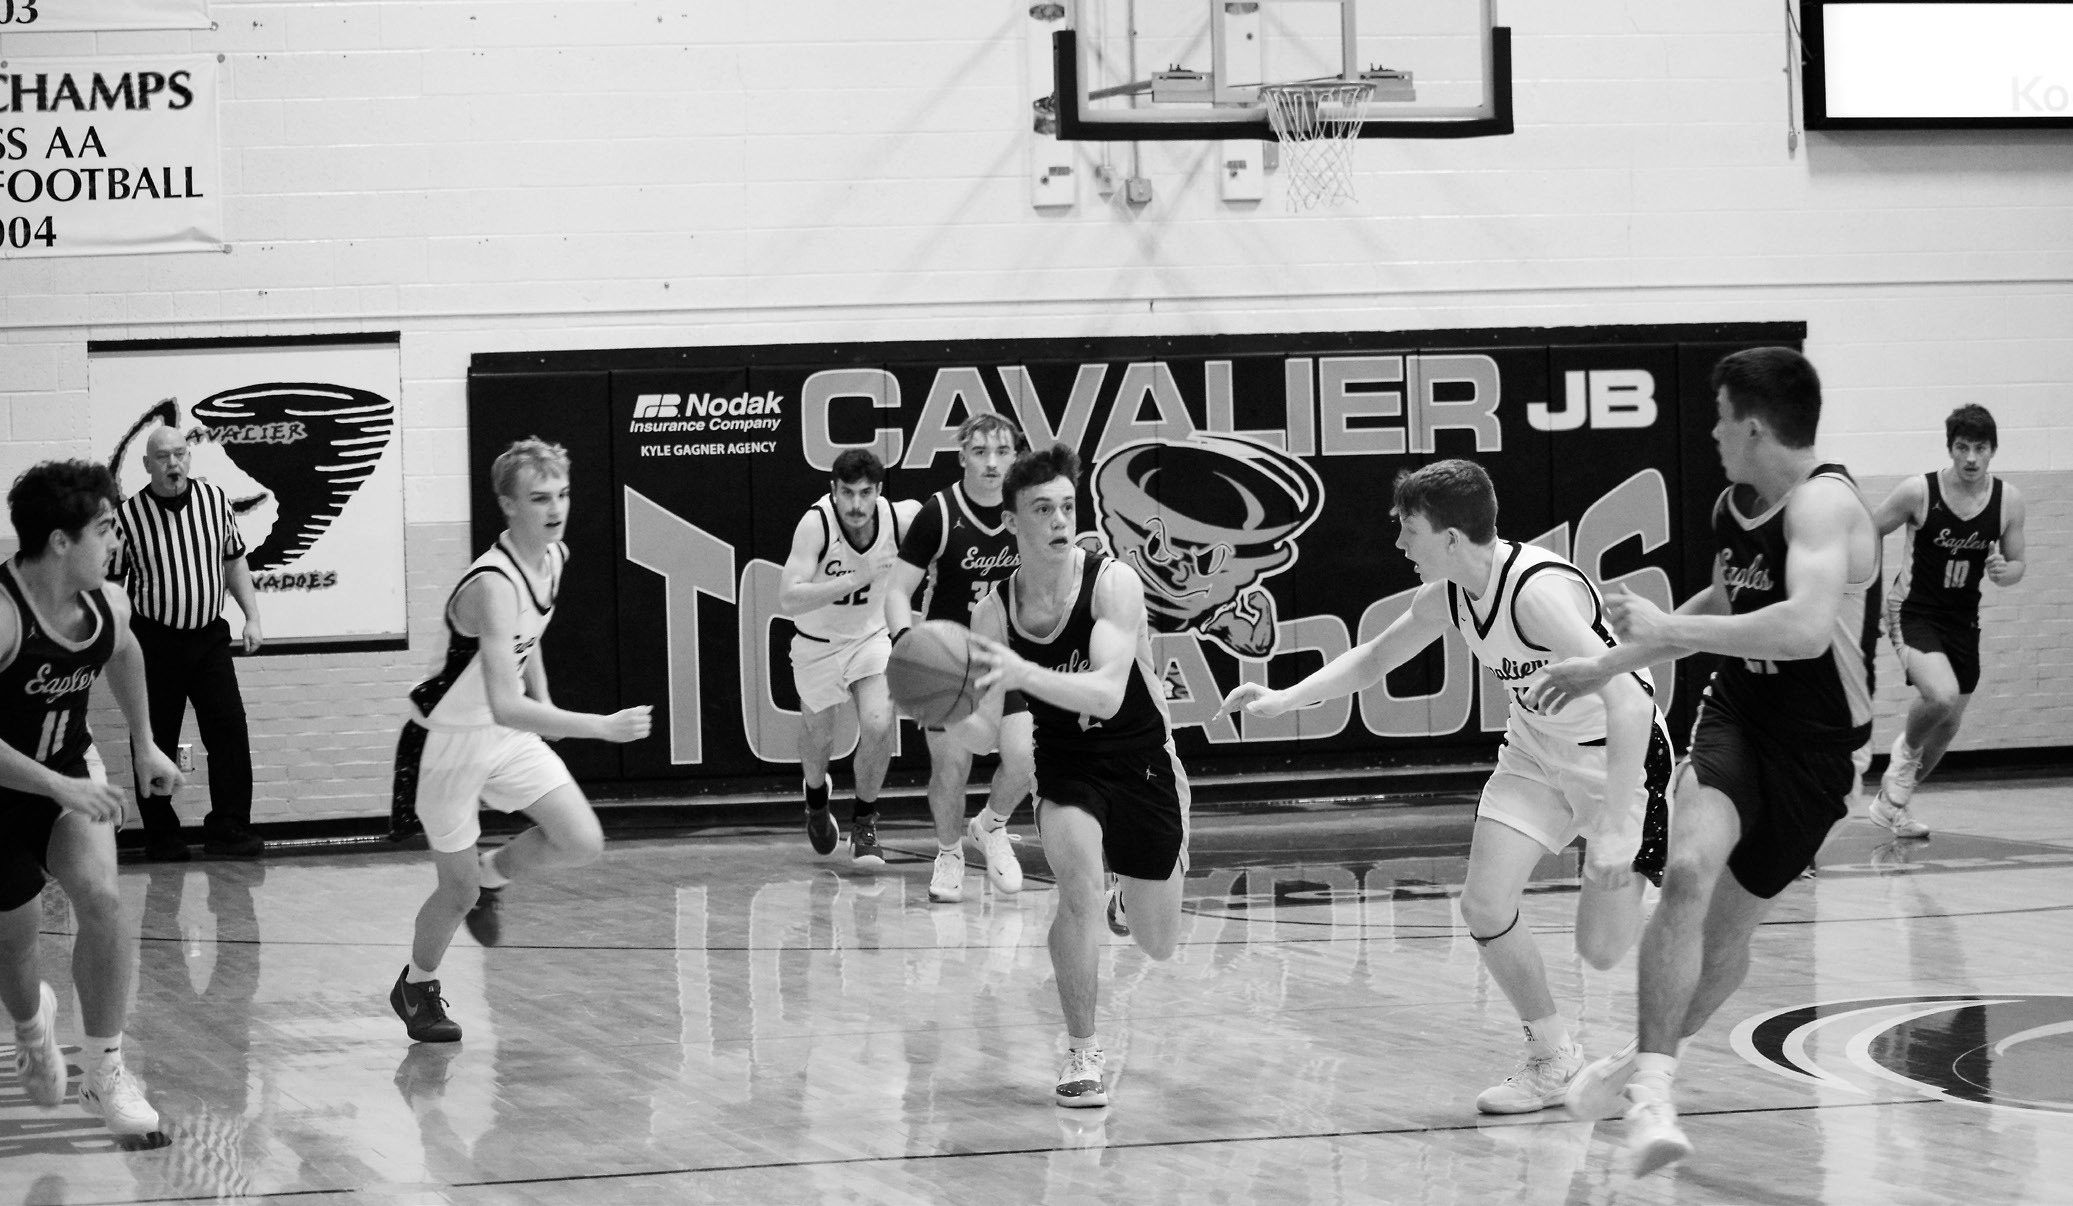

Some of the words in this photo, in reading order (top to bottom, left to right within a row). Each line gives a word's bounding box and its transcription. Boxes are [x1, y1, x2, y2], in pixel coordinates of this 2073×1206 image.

[0, 70, 194, 112] HAMPS
[2011, 75, 2073, 113] Ko
[0, 126, 28, 161] S
[45, 125, 107, 159] AA
[0, 166, 203, 203] OOTBALL
[0, 215, 57, 249] 04
[685, 390, 784, 417] Nodak
[801, 353, 1503, 472] CAVALIER
[1527, 369, 1658, 432] JB
[186, 423, 306, 442] AVALIER
[629, 420, 706, 433] Insurance
[709, 417, 781, 432] Company
[641, 445, 671, 457] KYLE
[673, 443, 725, 456] GAGNER
[727, 441, 777, 454] AGENCY
[1933, 528, 1987, 555] Eagles
[961, 545, 1022, 576] Eagles
[1944, 559, 1971, 588] 10
[35, 709, 70, 762] 11
